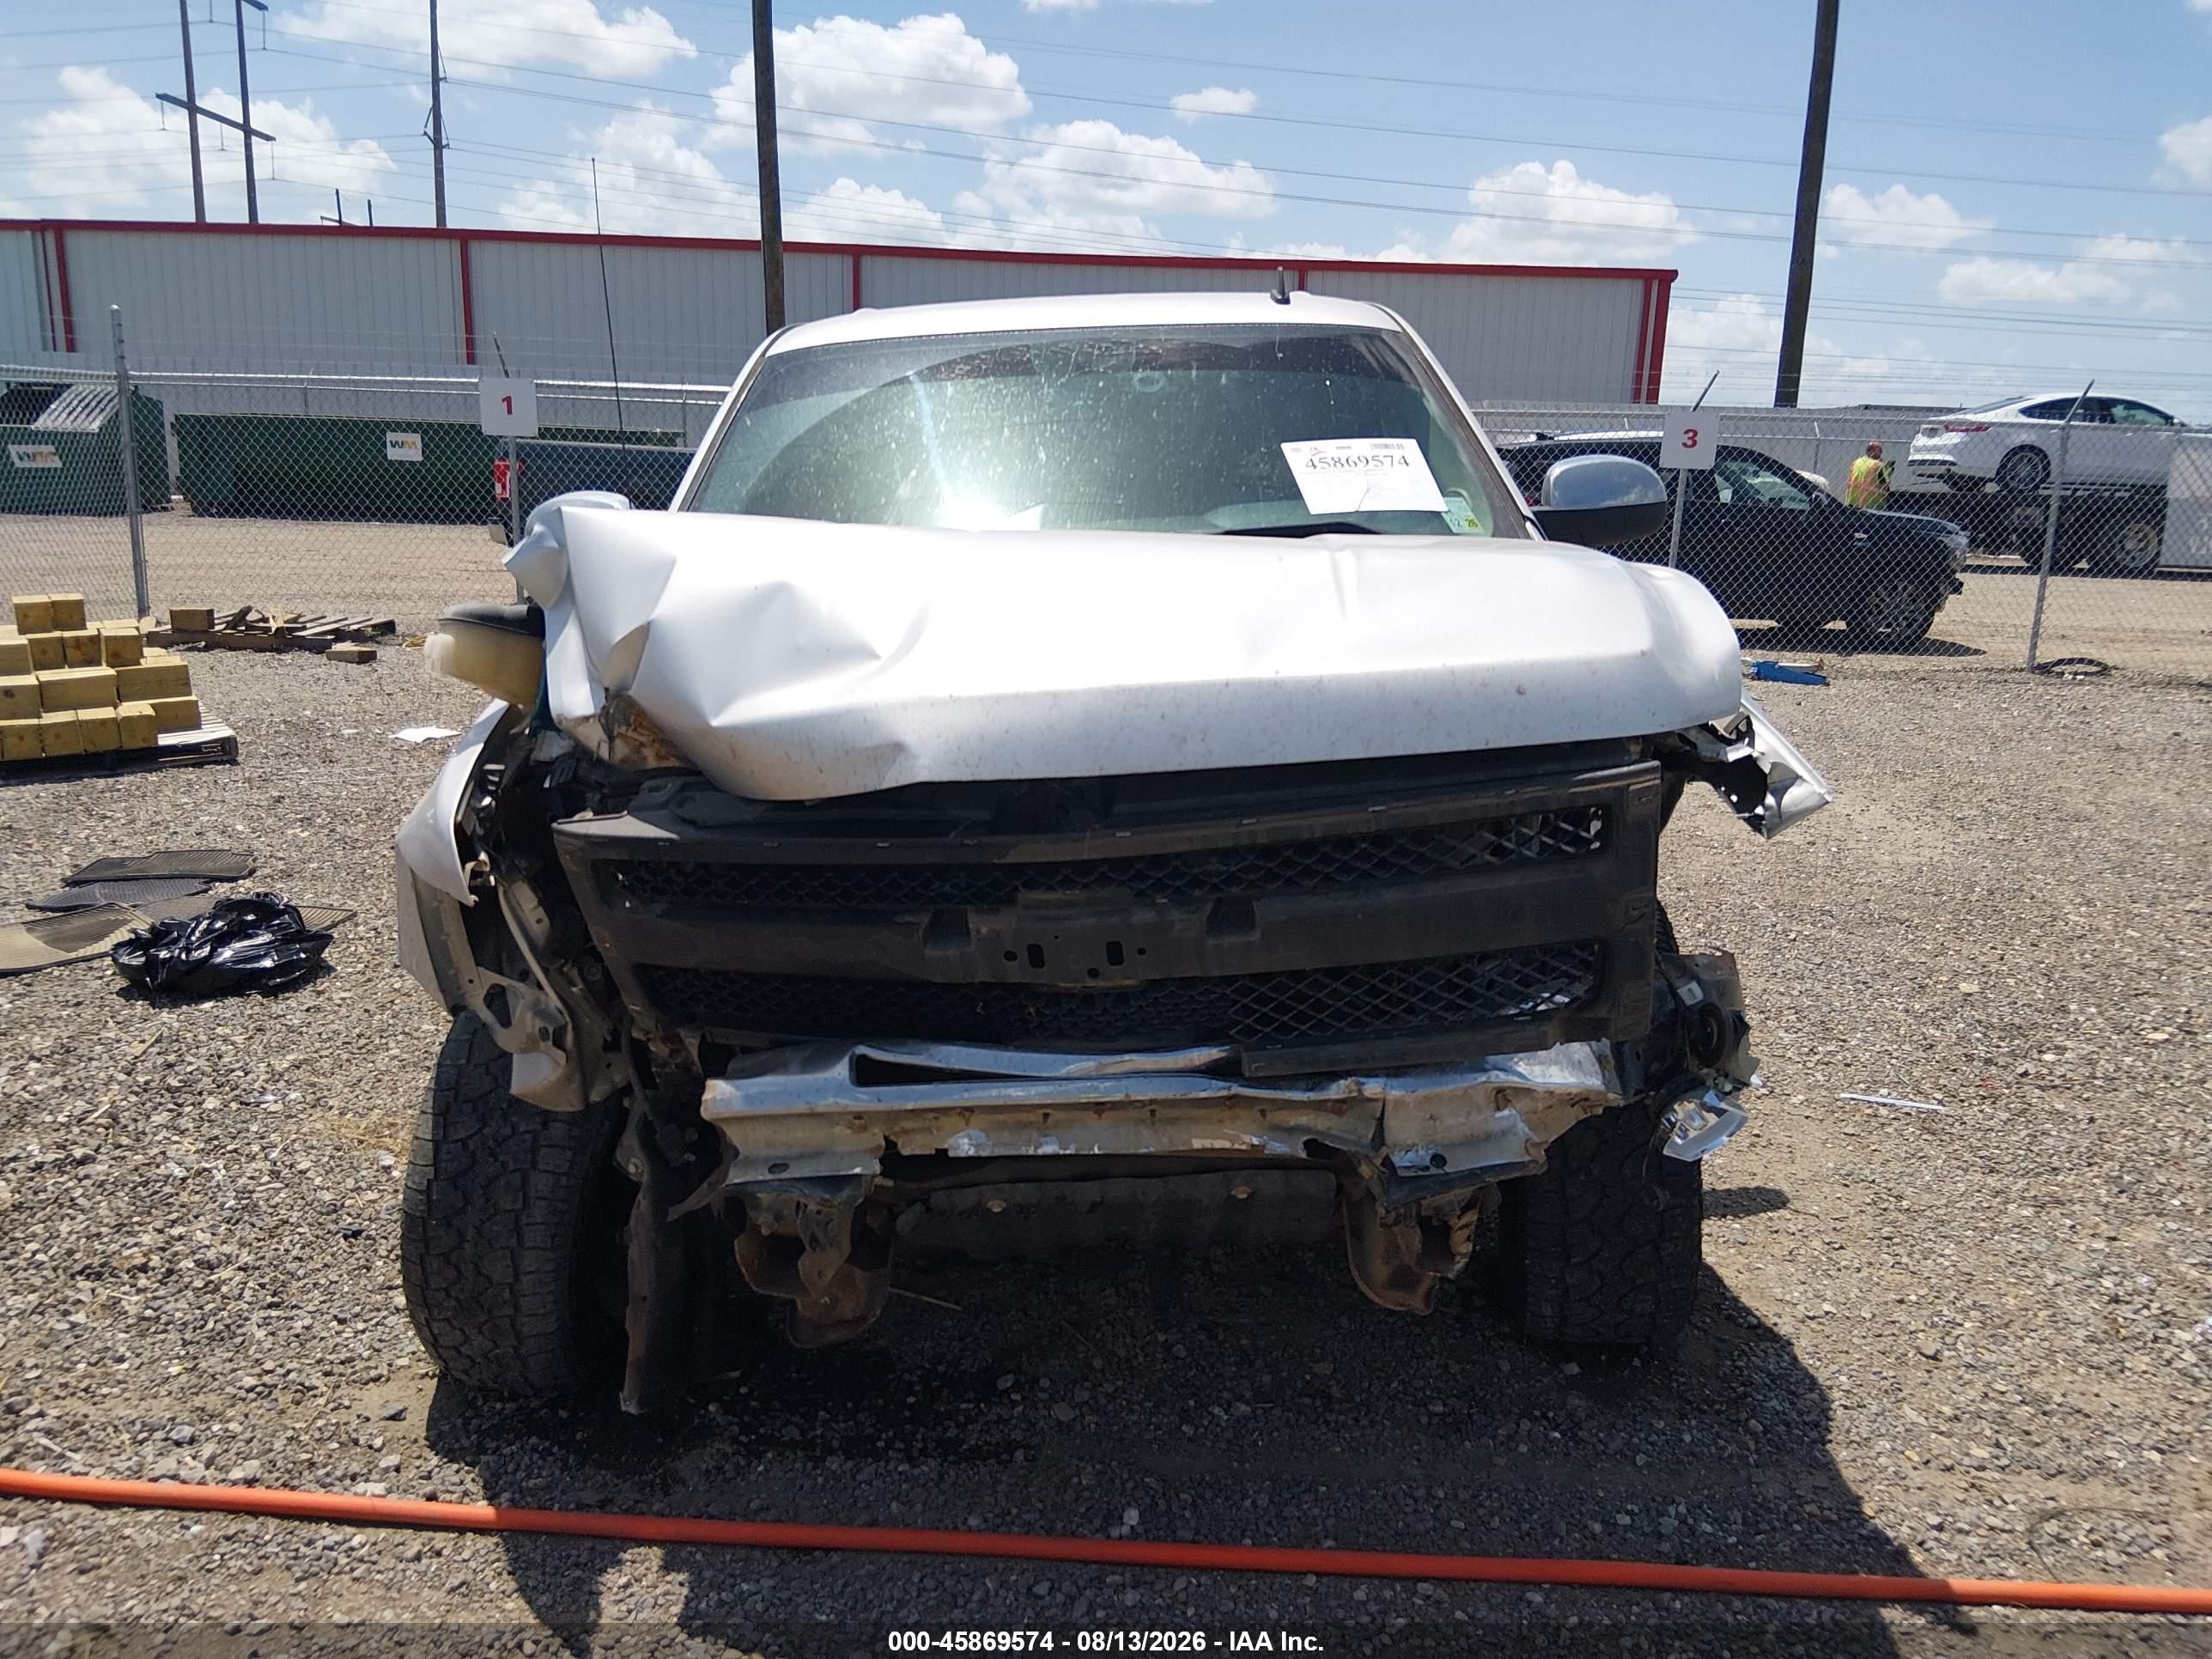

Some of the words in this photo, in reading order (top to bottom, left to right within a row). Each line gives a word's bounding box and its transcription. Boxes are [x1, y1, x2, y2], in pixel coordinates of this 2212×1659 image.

[501, 396, 514, 415] 1
[1681, 428, 1698, 449] 3
[1305, 454, 1410, 471] 45869574
